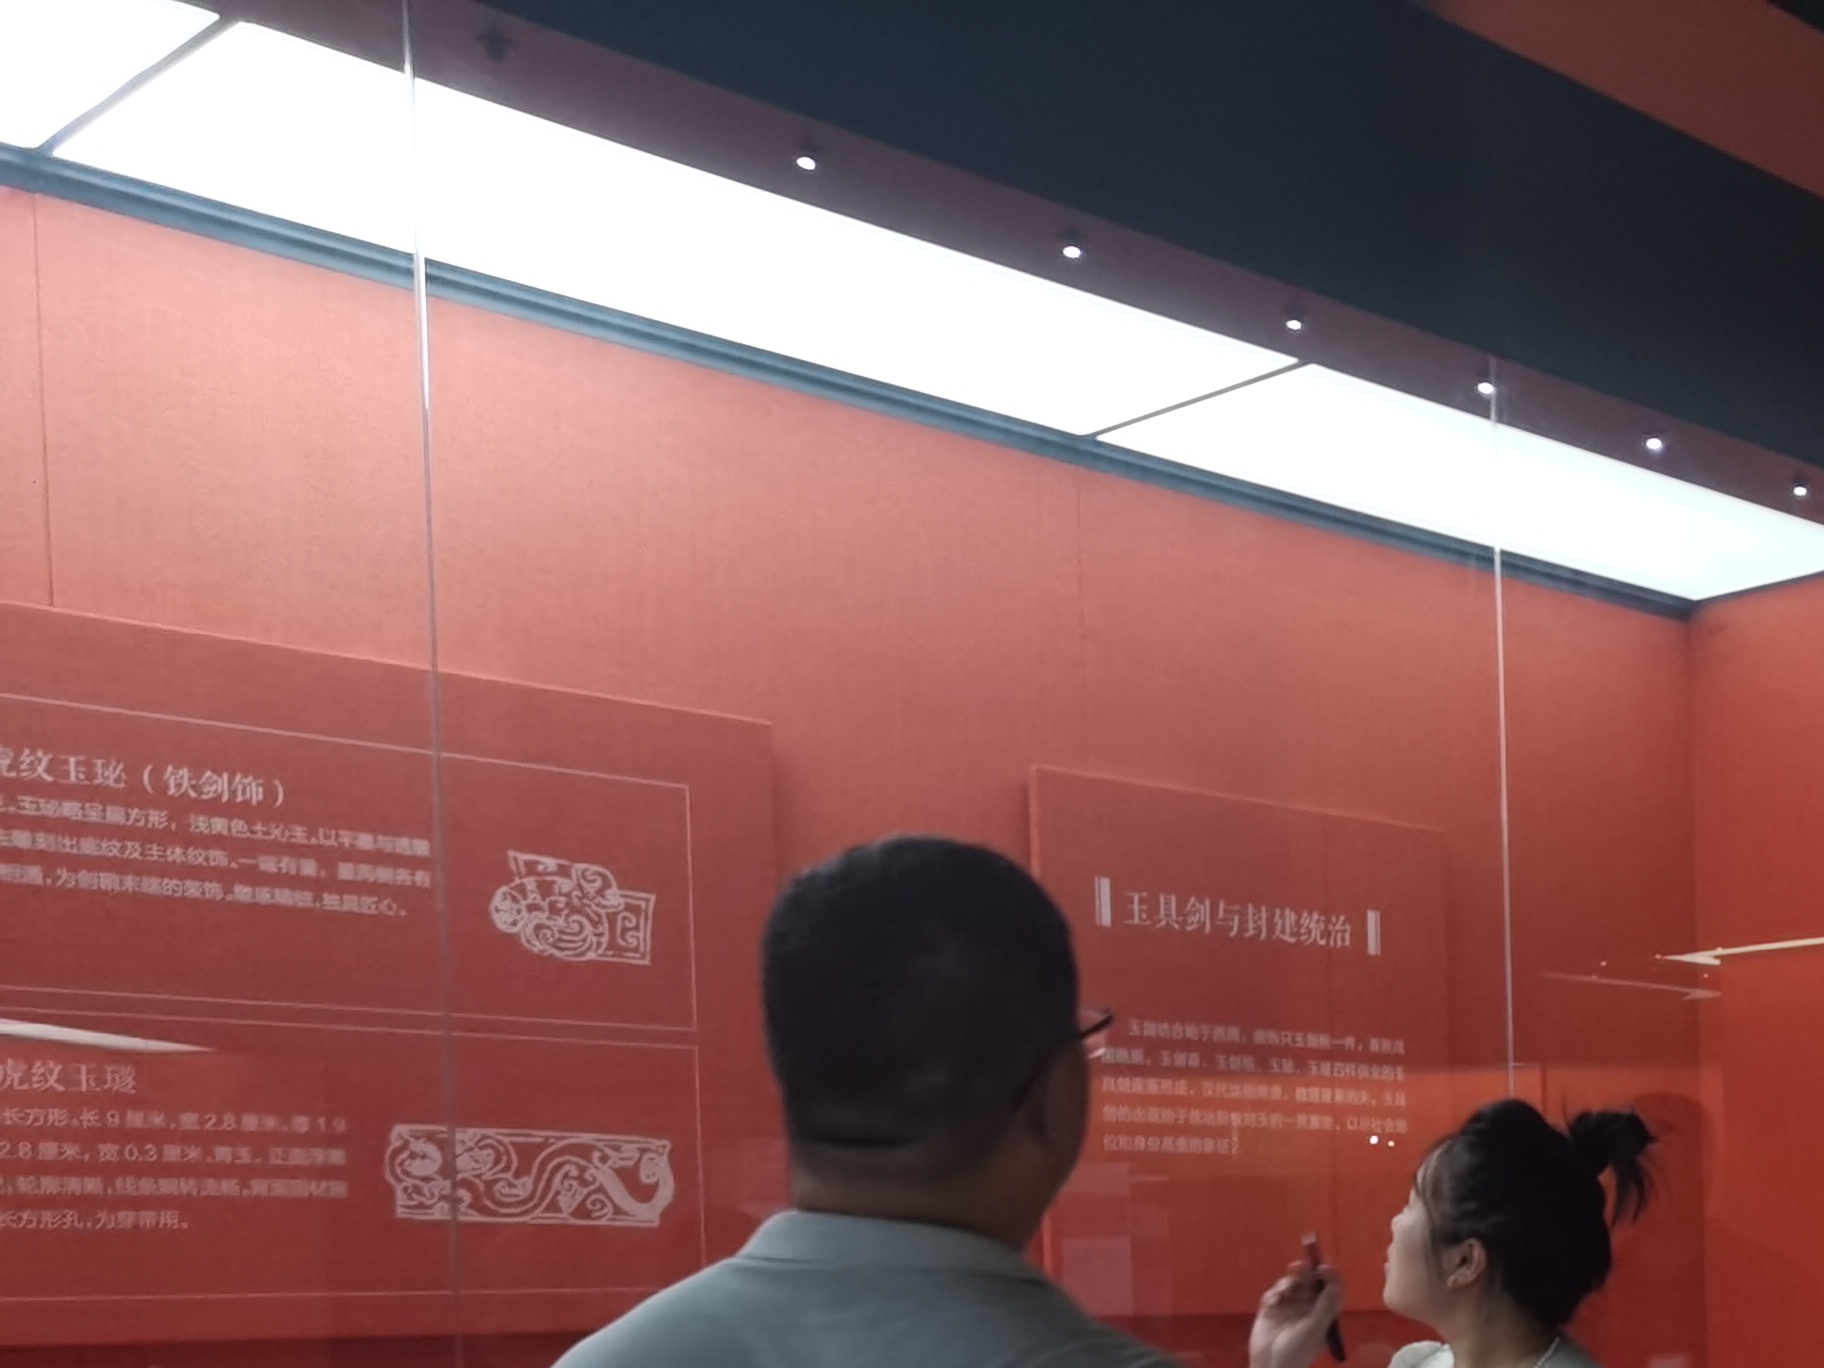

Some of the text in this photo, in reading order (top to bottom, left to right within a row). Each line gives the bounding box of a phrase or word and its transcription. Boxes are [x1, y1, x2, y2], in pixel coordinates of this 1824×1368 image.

[1124, 891, 1351, 948] 玉具剑与封建统治
